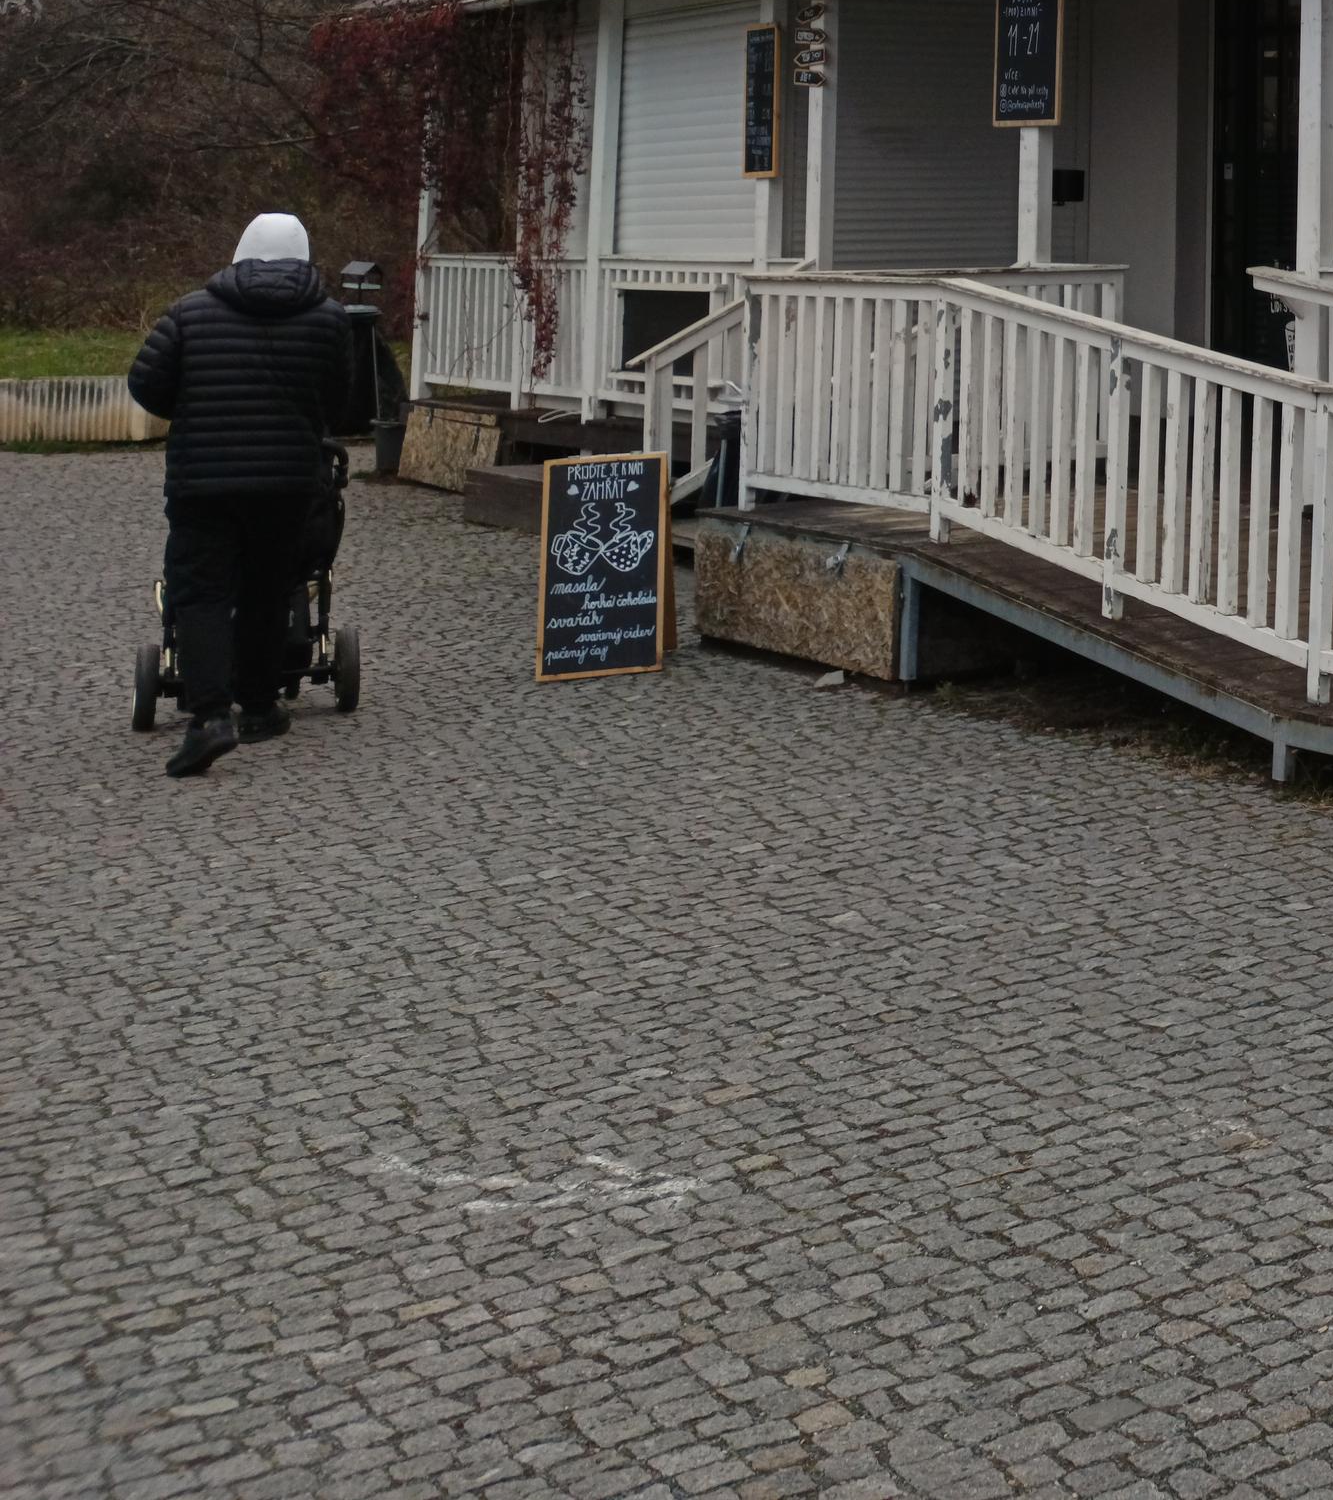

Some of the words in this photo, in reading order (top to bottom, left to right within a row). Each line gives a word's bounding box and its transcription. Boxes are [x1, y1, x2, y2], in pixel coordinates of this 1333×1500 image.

[621, 462, 627, 476] K
[581, 477, 626, 502] ZAHŘÁT
[550, 574, 606, 595] masala
[581, 593, 616, 610] horká
[616, 590, 657, 607] čokoláda
[546, 610, 604, 629] svařák
[575, 627, 623, 644] svařený
[623, 624, 656, 639] cider
[545, 645, 589, 666] pečený
[590, 644, 608, 662] čaj
